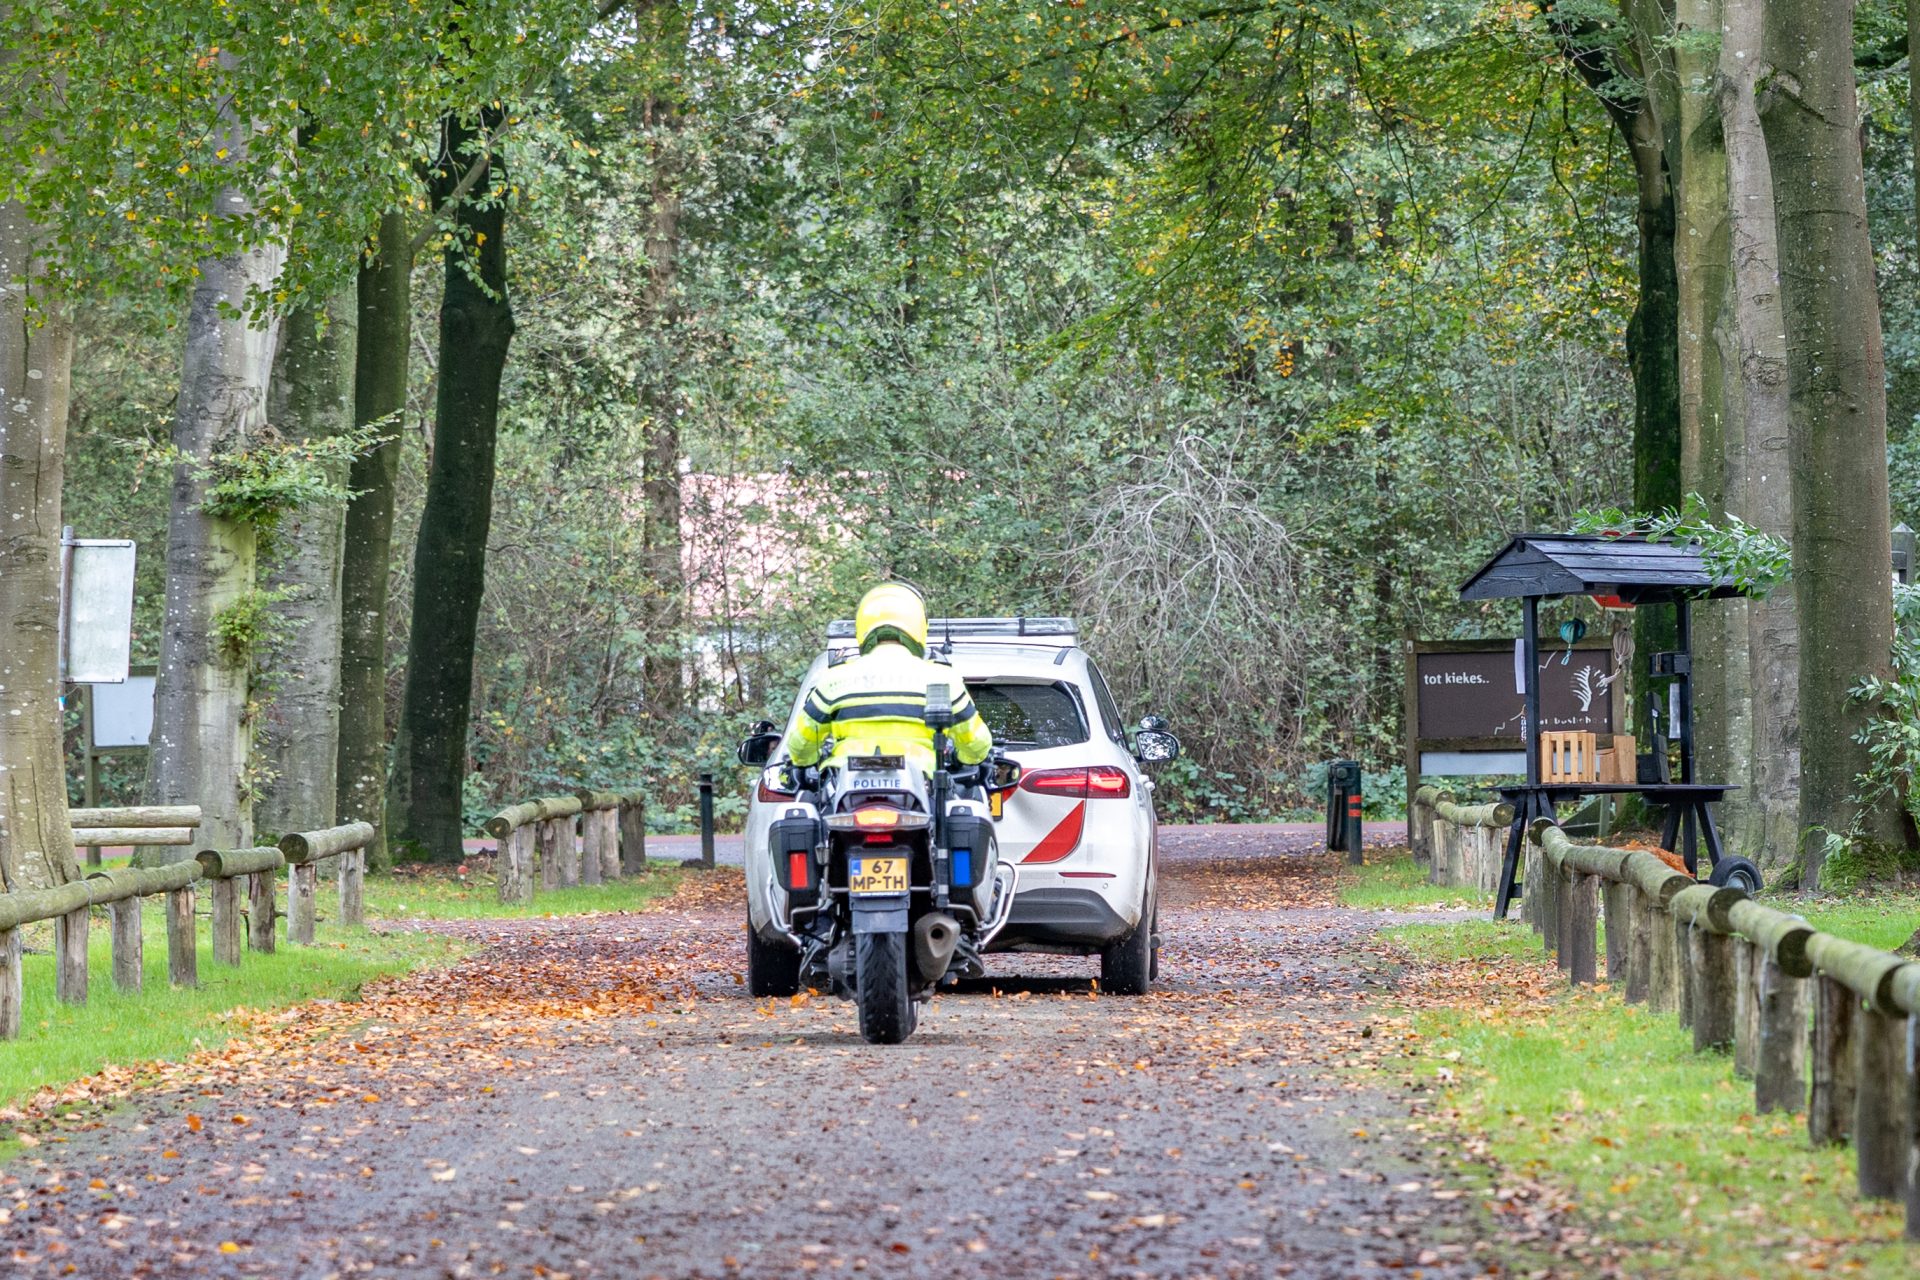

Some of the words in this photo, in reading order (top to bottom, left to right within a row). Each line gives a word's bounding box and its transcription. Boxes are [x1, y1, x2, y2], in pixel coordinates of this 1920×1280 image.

[1424, 674, 1442, 685] tot
[853, 779, 901, 789] POLITIE
[872, 860, 894, 874] 67
[853, 876, 904, 890] MP-TH
